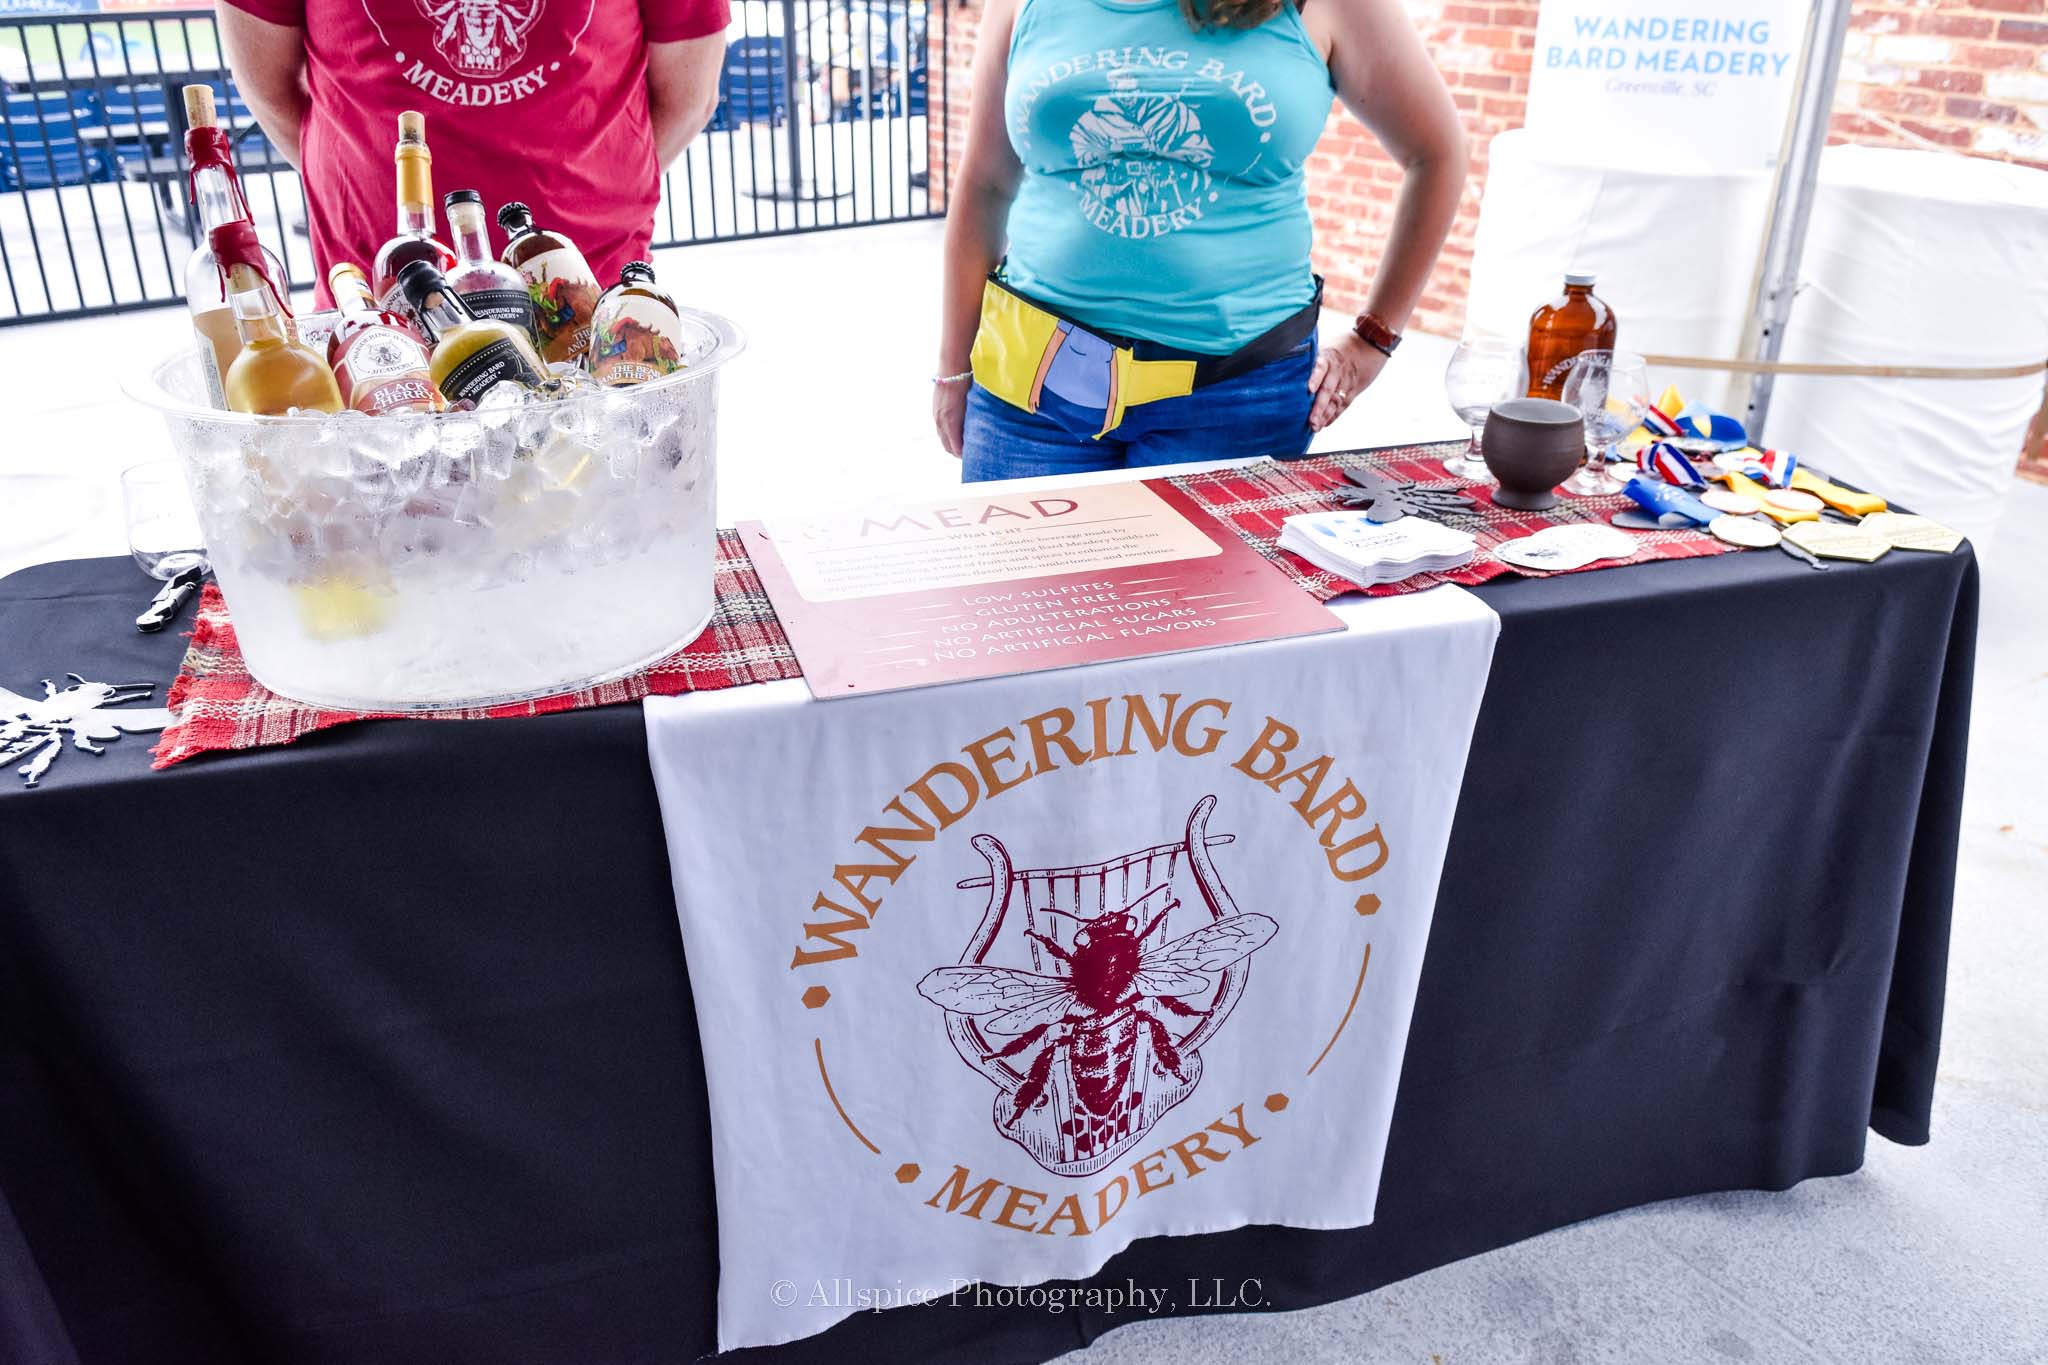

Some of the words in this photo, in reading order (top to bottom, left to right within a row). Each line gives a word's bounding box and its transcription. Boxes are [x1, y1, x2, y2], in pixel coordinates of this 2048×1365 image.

[1574, 16, 1770, 45] WANDERING
[1546, 47, 1627, 70] BARD
[1634, 49, 1791, 77] MEADERY
[403, 60, 548, 107] MEADERY
[1017, 47, 1190, 135] WANDERING
[1196, 58, 1277, 128] BARD
[1079, 191, 1204, 240] MEADERY
[458, 370, 489, 398] WANDERING
[488, 361, 505, 374] BARD
[471, 373, 498, 394] MEADERY
[612, 364, 634, 374] THE
[624, 372, 645, 380] THE
[373, 390, 434, 409] CHERRY
[374, 382, 427, 401] BLACK
[860, 498, 1079, 537] MEAD
[962, 593, 1013, 606] LOW
[1021, 581, 1115, 598] SULFITES
[976, 599, 1064, 617] GLUTEN
[1071, 591, 1121, 606] FREE
[932, 635, 972, 649] NO
[980, 616, 1107, 643] ARTIFICIAL
[1115, 607, 1197, 625] SUGARS
[942, 622, 979, 634] NO
[988, 598, 1171, 627] ADULTERATIONS
[932, 648, 977, 663] NO
[986, 631, 1115, 657] ARTIFICIAL
[1120, 617, 1217, 638] FLAVORS
[790, 693, 1233, 971] WANDERING
[1231, 716, 1389, 882] BARD
[924, 1104, 1263, 1237] MEADERY
